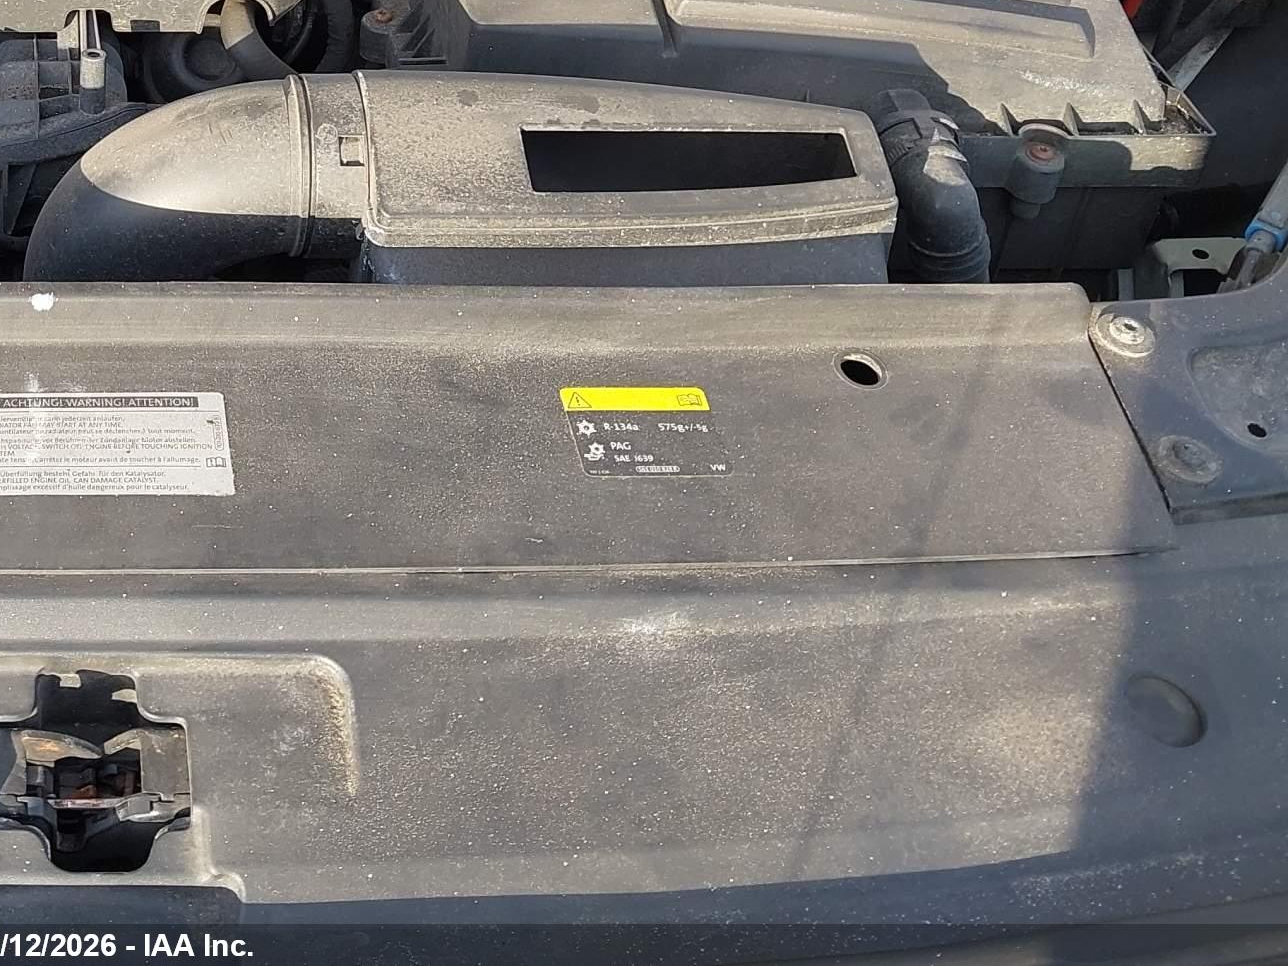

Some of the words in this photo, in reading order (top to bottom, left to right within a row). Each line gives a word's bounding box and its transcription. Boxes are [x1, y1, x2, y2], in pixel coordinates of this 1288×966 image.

[65, 398, 126, 407] WARNING!
[128, 398, 194, 407] ATTENTION!
[603, 422, 640, 431] R-134a
[610, 441, 631, 450] PAG
[614, 454, 630, 462] SAE
